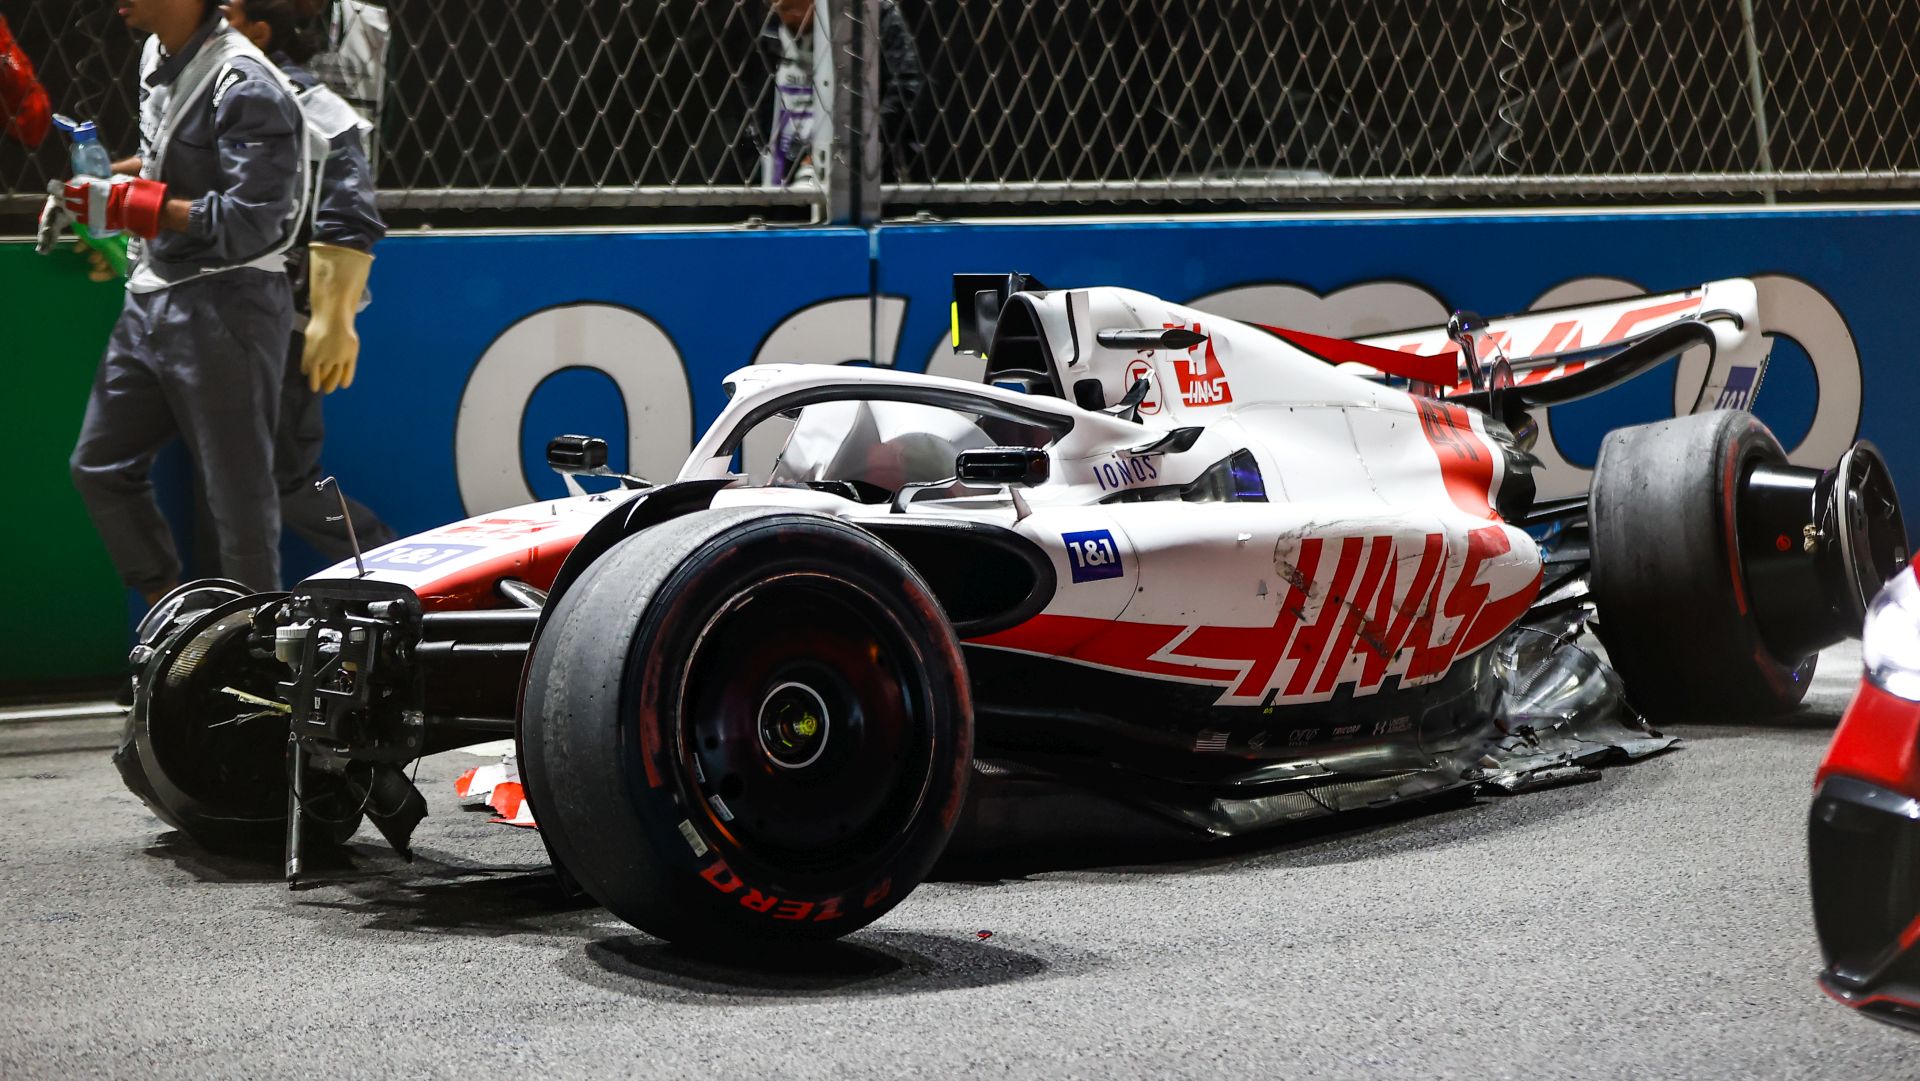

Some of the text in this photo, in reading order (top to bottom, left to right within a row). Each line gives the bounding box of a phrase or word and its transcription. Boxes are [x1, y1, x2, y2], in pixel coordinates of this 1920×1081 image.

[1181, 376, 1228, 404] HAAS
[1093, 455, 1157, 491] IONOS
[371, 546, 458, 567] 1&1
[1069, 538, 1115, 568] 1&1
[1165, 524, 1511, 702] HAAS
[698, 858, 848, 923] ZERO
